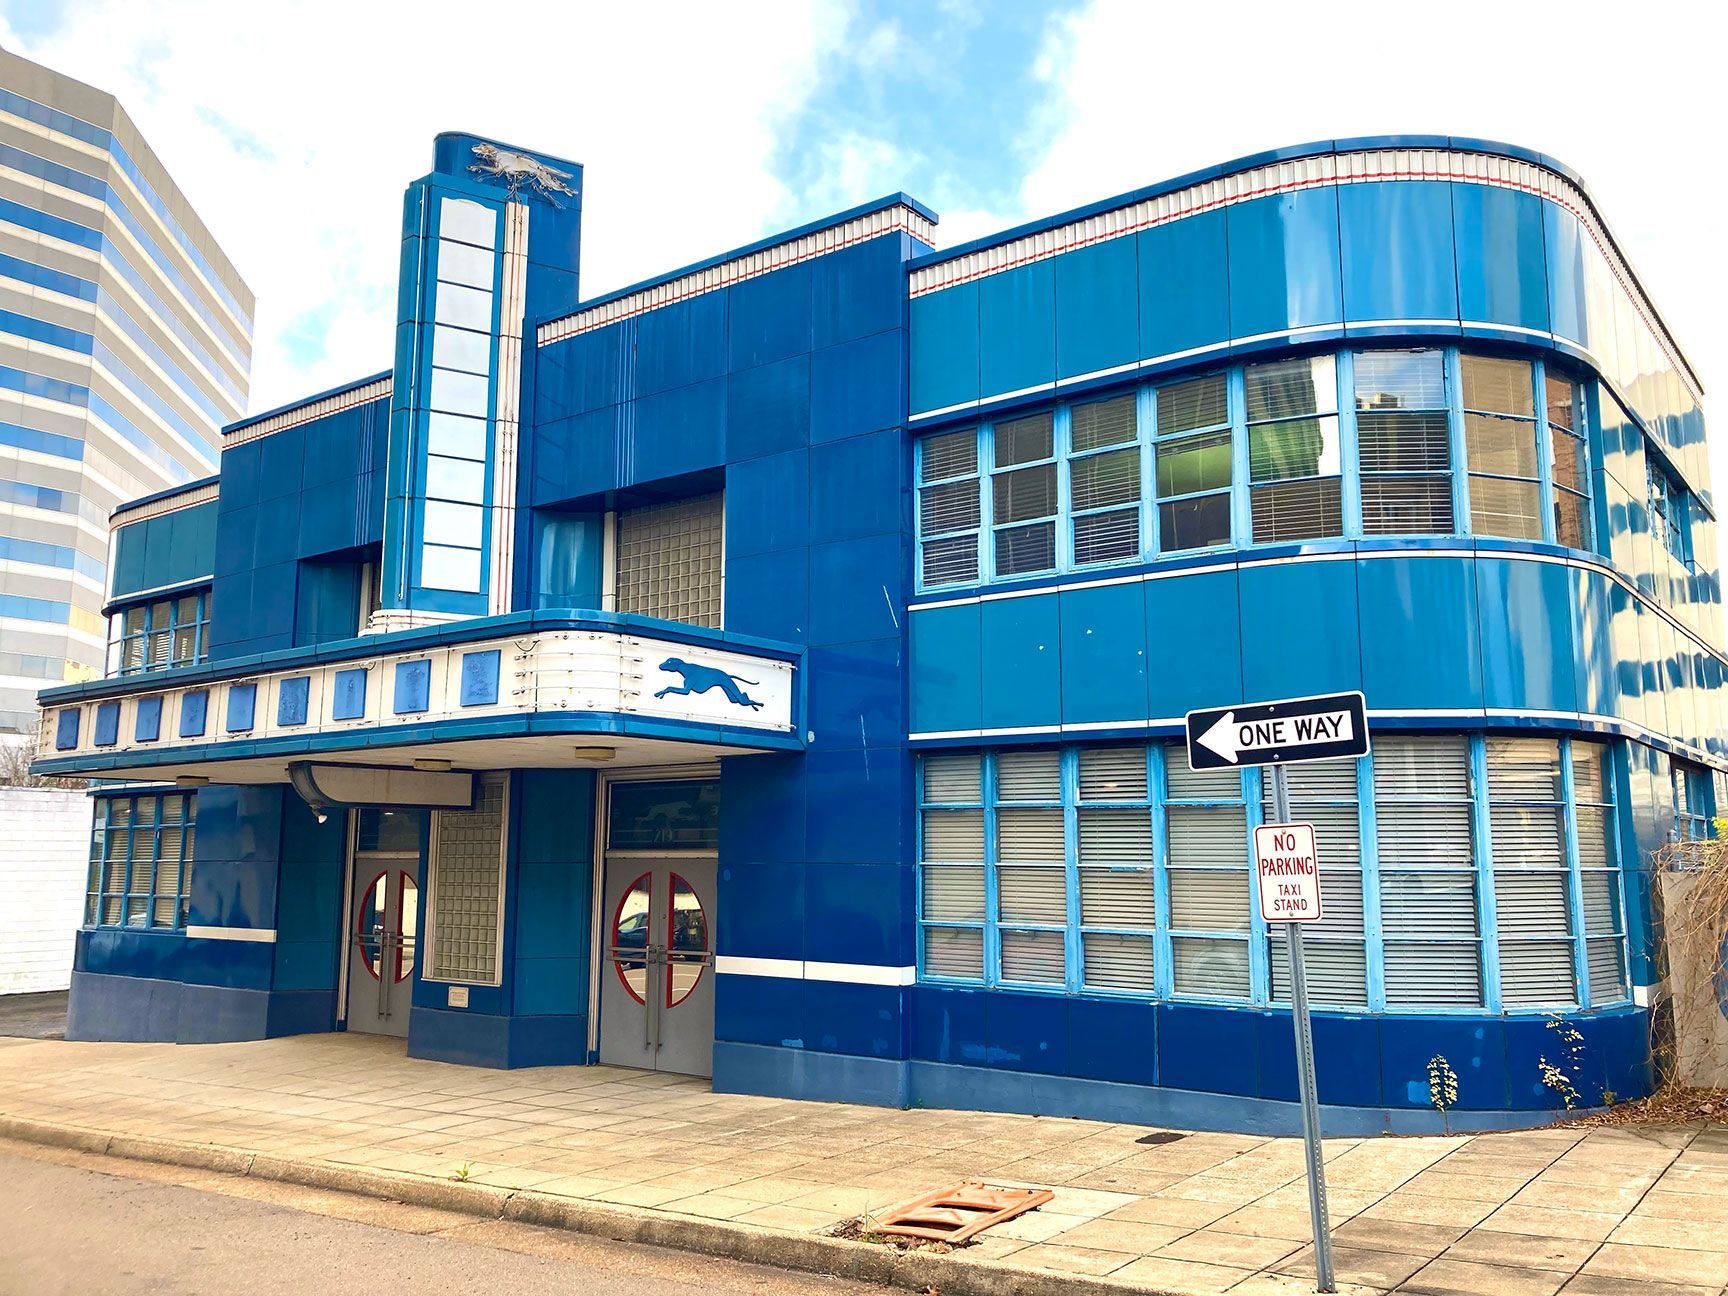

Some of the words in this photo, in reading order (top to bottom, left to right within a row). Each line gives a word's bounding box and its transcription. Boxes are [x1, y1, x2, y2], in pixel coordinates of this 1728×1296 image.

[1239, 721, 1287, 747] ONE
[1294, 714, 1344, 741] WAY
[1273, 833, 1296, 852] NO
[1261, 856, 1314, 876] PARKING
[1277, 883, 1302, 896] TAXI
[1273, 898, 1308, 912] STAND
